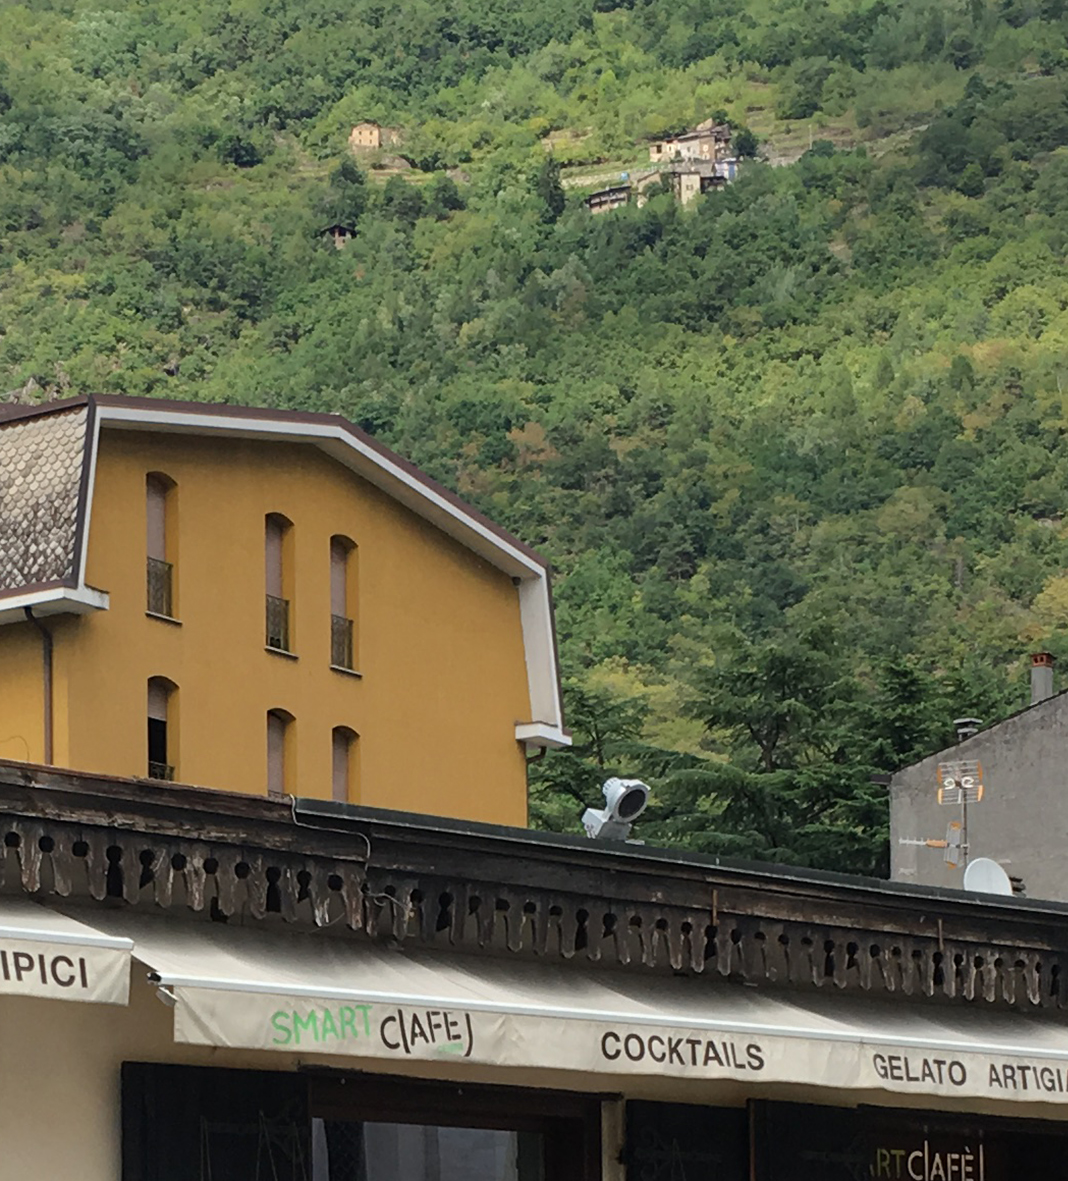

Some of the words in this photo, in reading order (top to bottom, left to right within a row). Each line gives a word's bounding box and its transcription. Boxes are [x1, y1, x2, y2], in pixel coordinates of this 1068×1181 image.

[0, 950, 88, 989] IPICI
[271, 1005, 373, 1045] SMART
[601, 1031, 765, 1071] COCKTAILS
[873, 1053, 967, 1087] GELATO
